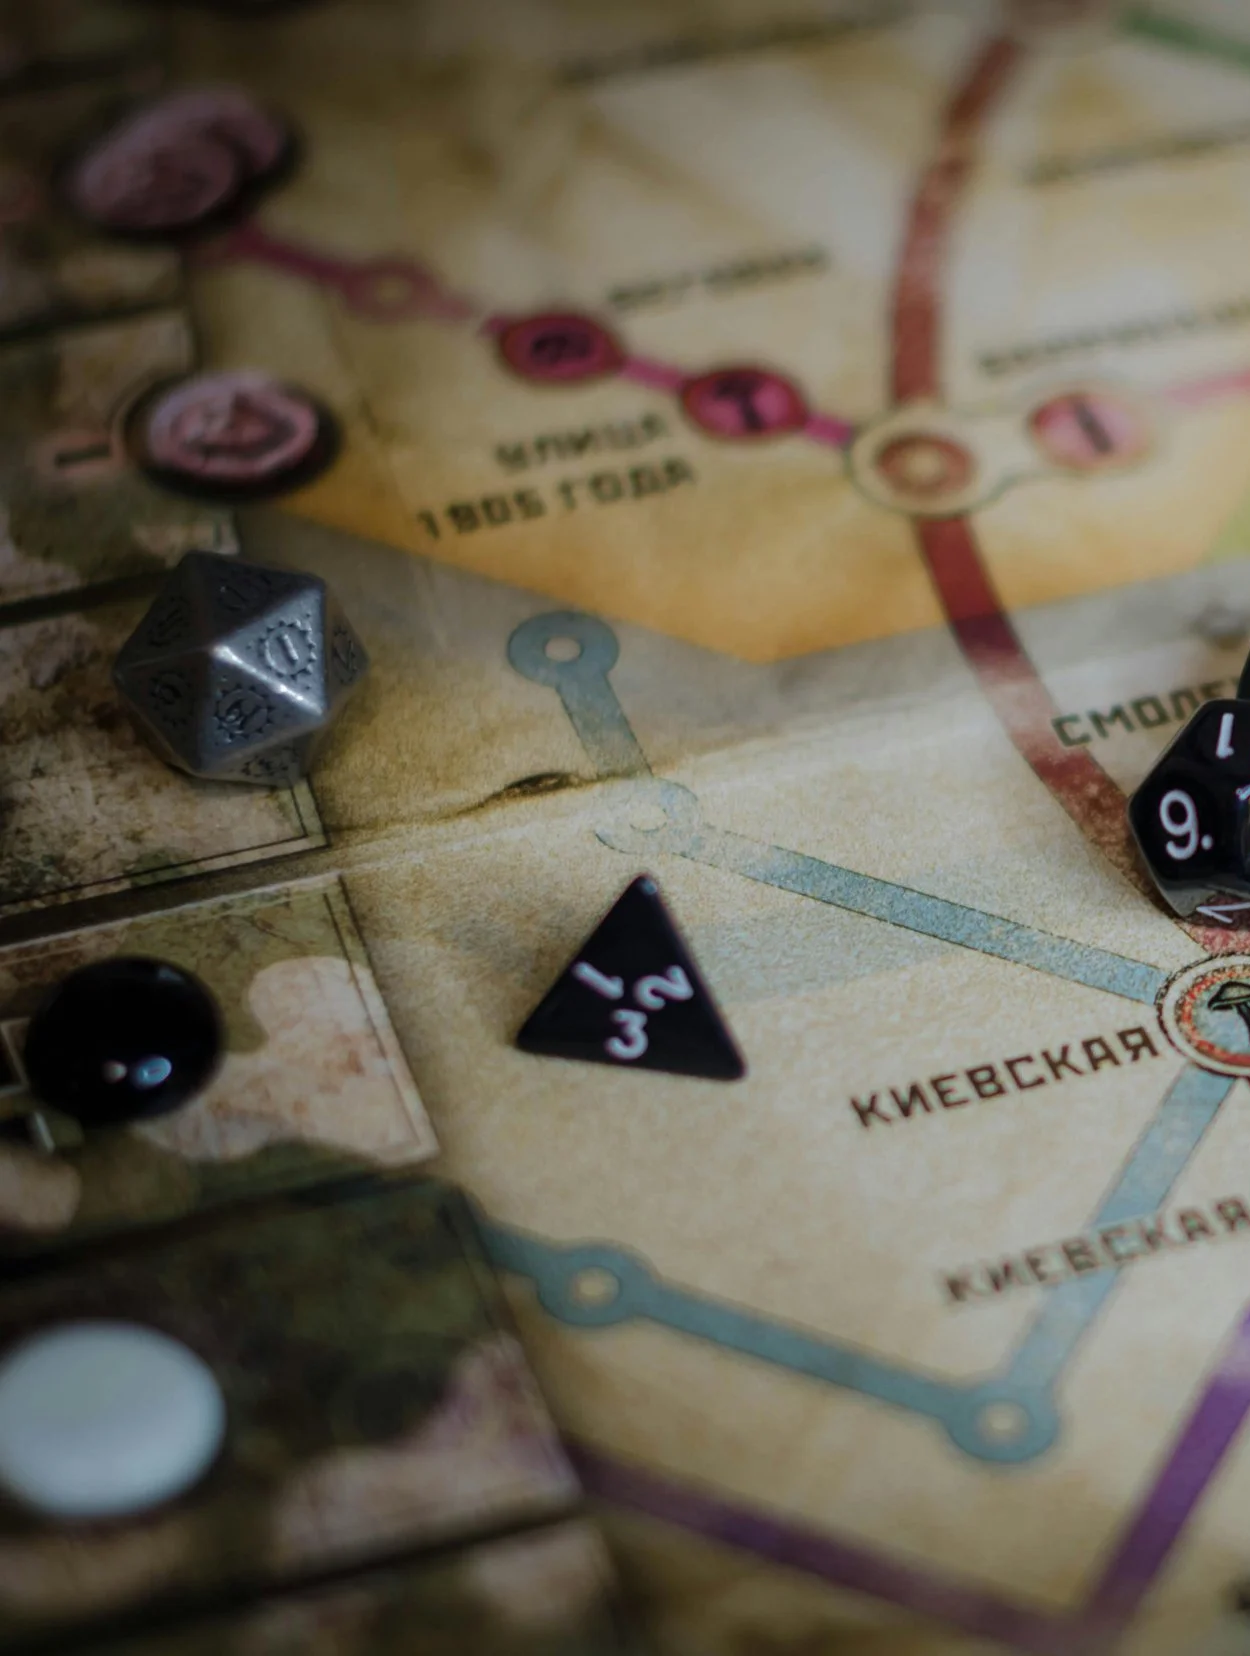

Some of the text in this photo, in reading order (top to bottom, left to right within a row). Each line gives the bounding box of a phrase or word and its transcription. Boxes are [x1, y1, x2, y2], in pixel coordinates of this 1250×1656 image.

[416, 490, 546, 541] 1905
[572, 961, 624, 1000] 1
[634, 964, 694, 1010] 2
[605, 1008, 649, 1060] 3
[850, 1025, 1160, 1130] КИЕВСКАЯ
